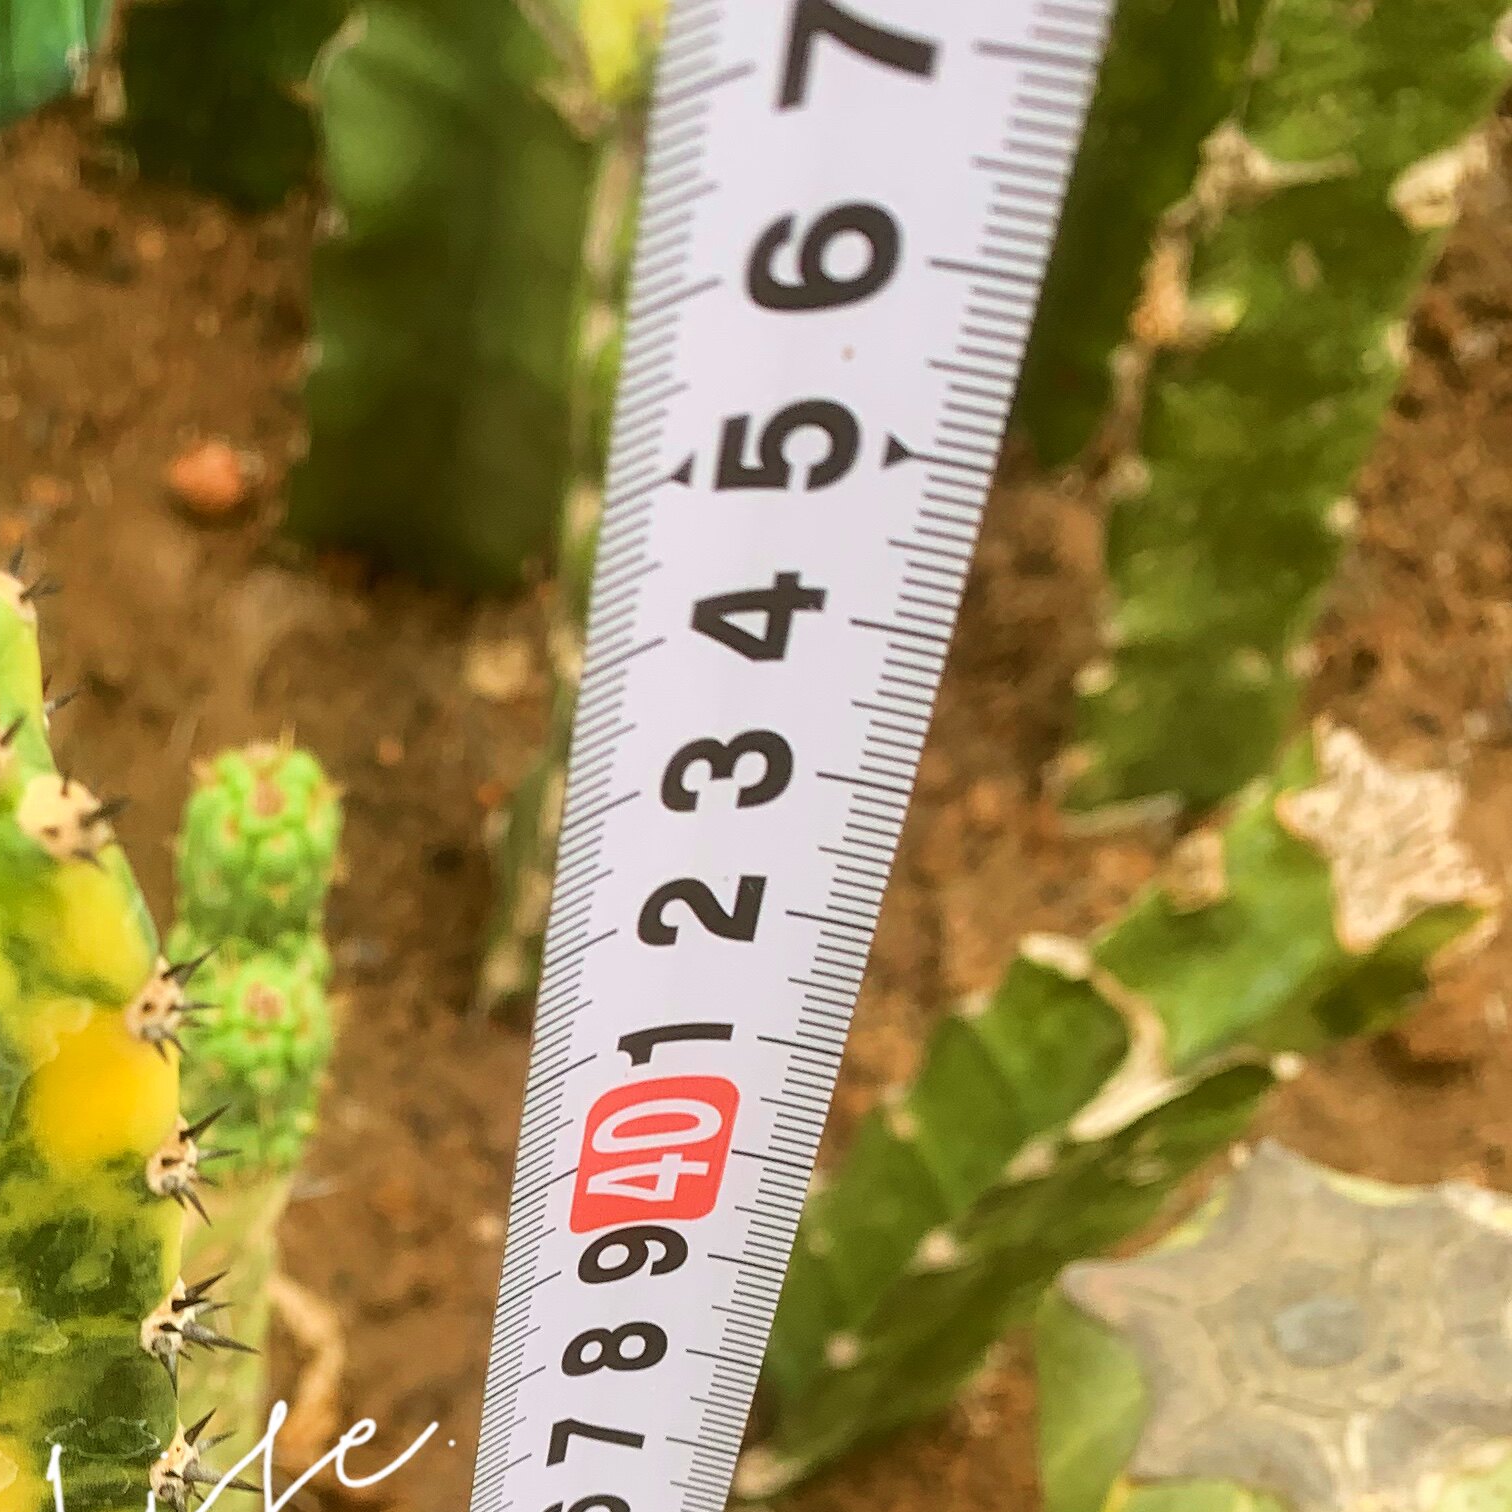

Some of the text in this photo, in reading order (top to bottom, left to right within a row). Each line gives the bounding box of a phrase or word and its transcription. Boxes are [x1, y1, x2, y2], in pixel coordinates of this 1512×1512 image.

[775, 0, 942, 112] 7
[745, 201, 904, 311] 6
[712, 400, 862, 491] 5
[690, 571, 828, 661] 4
[661, 730, 794, 812] 3
[638, 875, 766, 946] 2
[617, 1023, 734, 1066] 1
[586, 1097, 723, 1201] 40
[578, 1225, 689, 1284] 9
[561, 1321, 668, 1377] 8
[546, 1418, 646, 1467] 7
